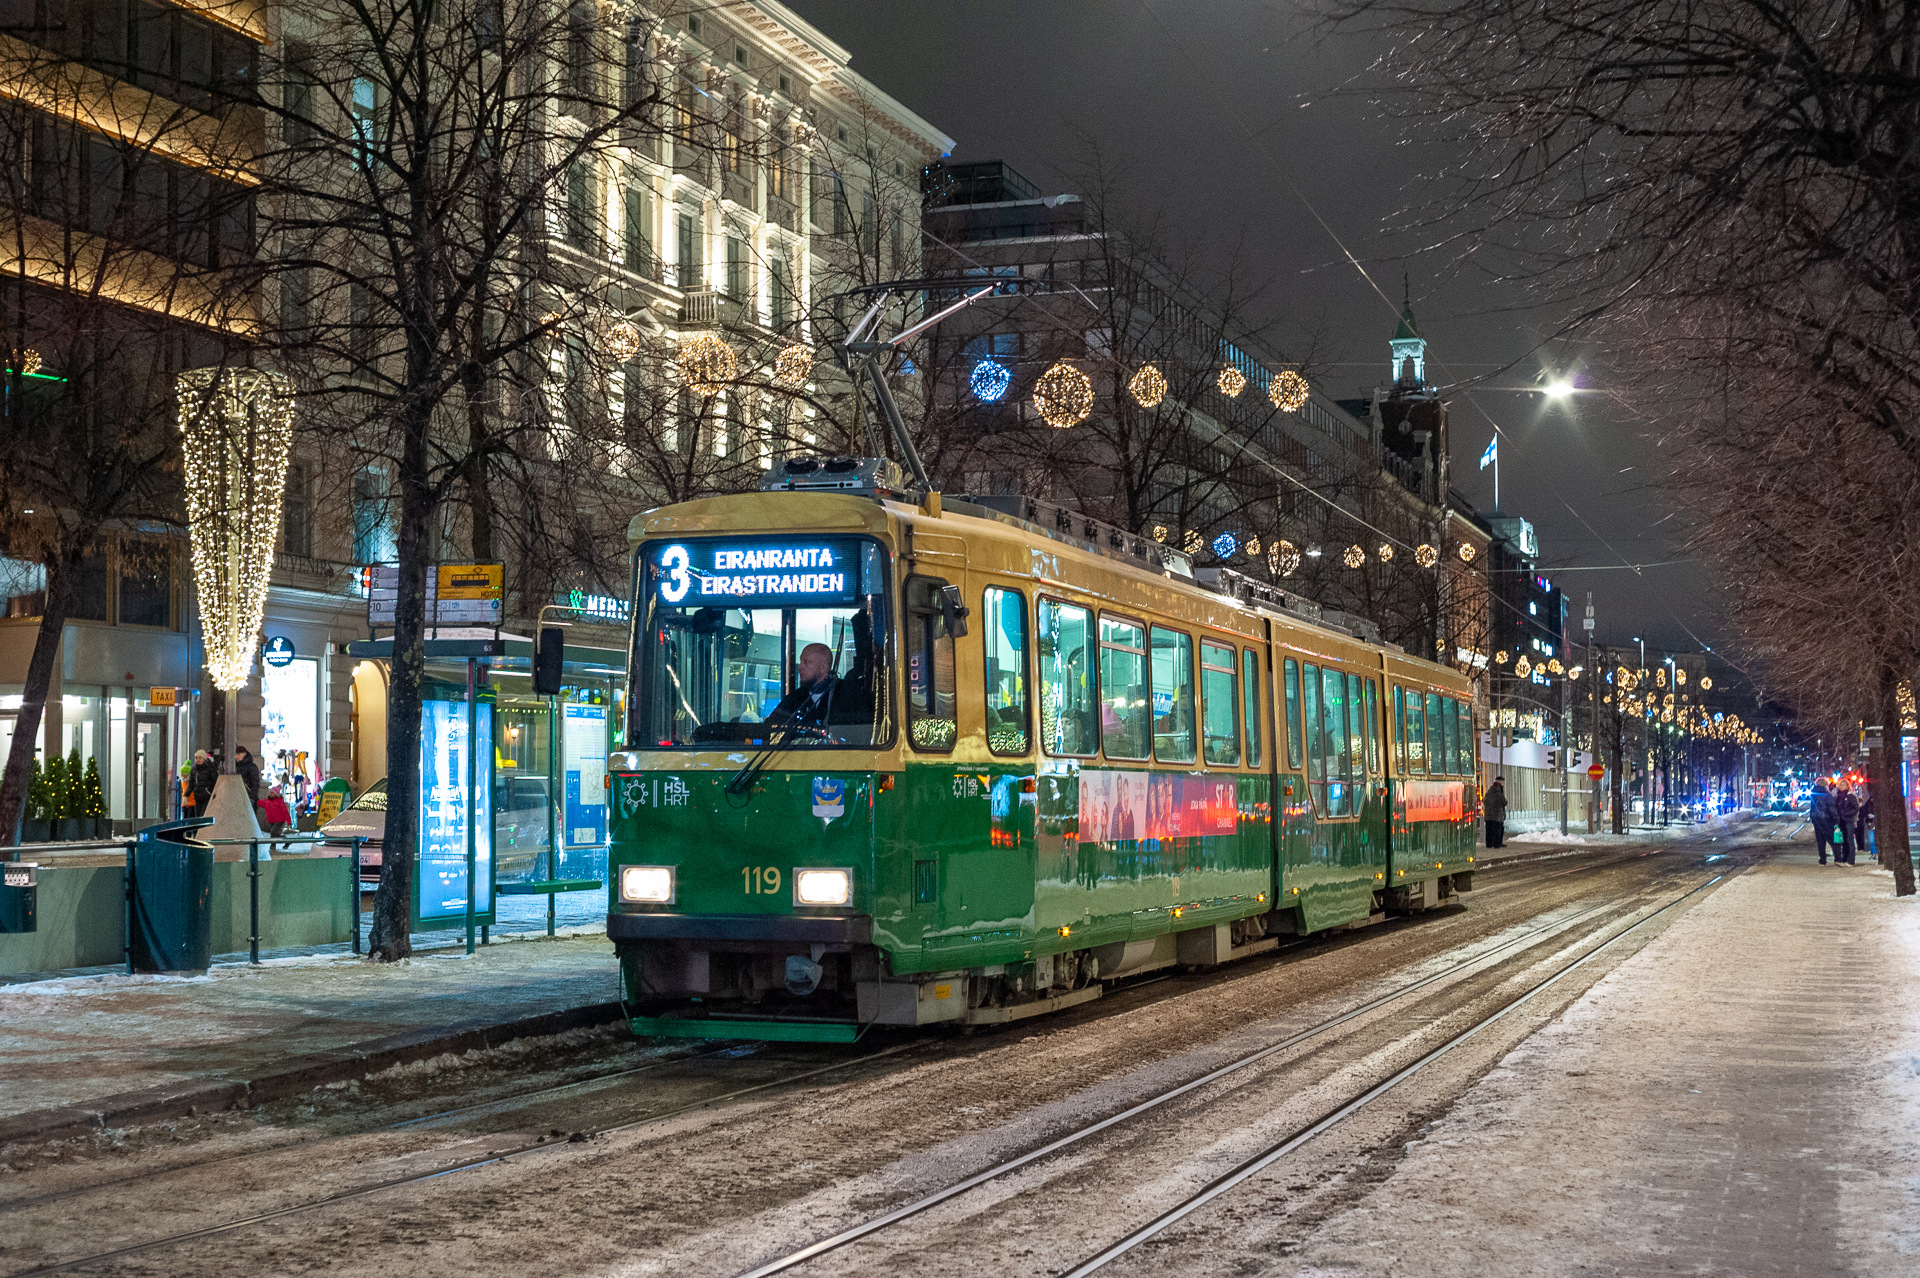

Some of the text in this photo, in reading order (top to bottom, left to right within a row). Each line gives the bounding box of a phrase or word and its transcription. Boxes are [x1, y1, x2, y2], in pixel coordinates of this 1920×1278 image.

[715, 548, 833, 570] EIRANRANTA
[374, 568, 380, 578] 3
[661, 545, 690, 602] 3
[373, 581, 379, 589] 6
[701, 573, 844, 595] EIRASTRANDEN
[371, 602, 381, 612] 10
[155, 691, 173, 701] TAXI
[664, 781, 690, 794] HSL
[967, 778, 978, 788] HSL
[967, 787, 978, 797] HRT
[664, 792, 690, 806] HRT
[741, 866, 781, 895] 119
